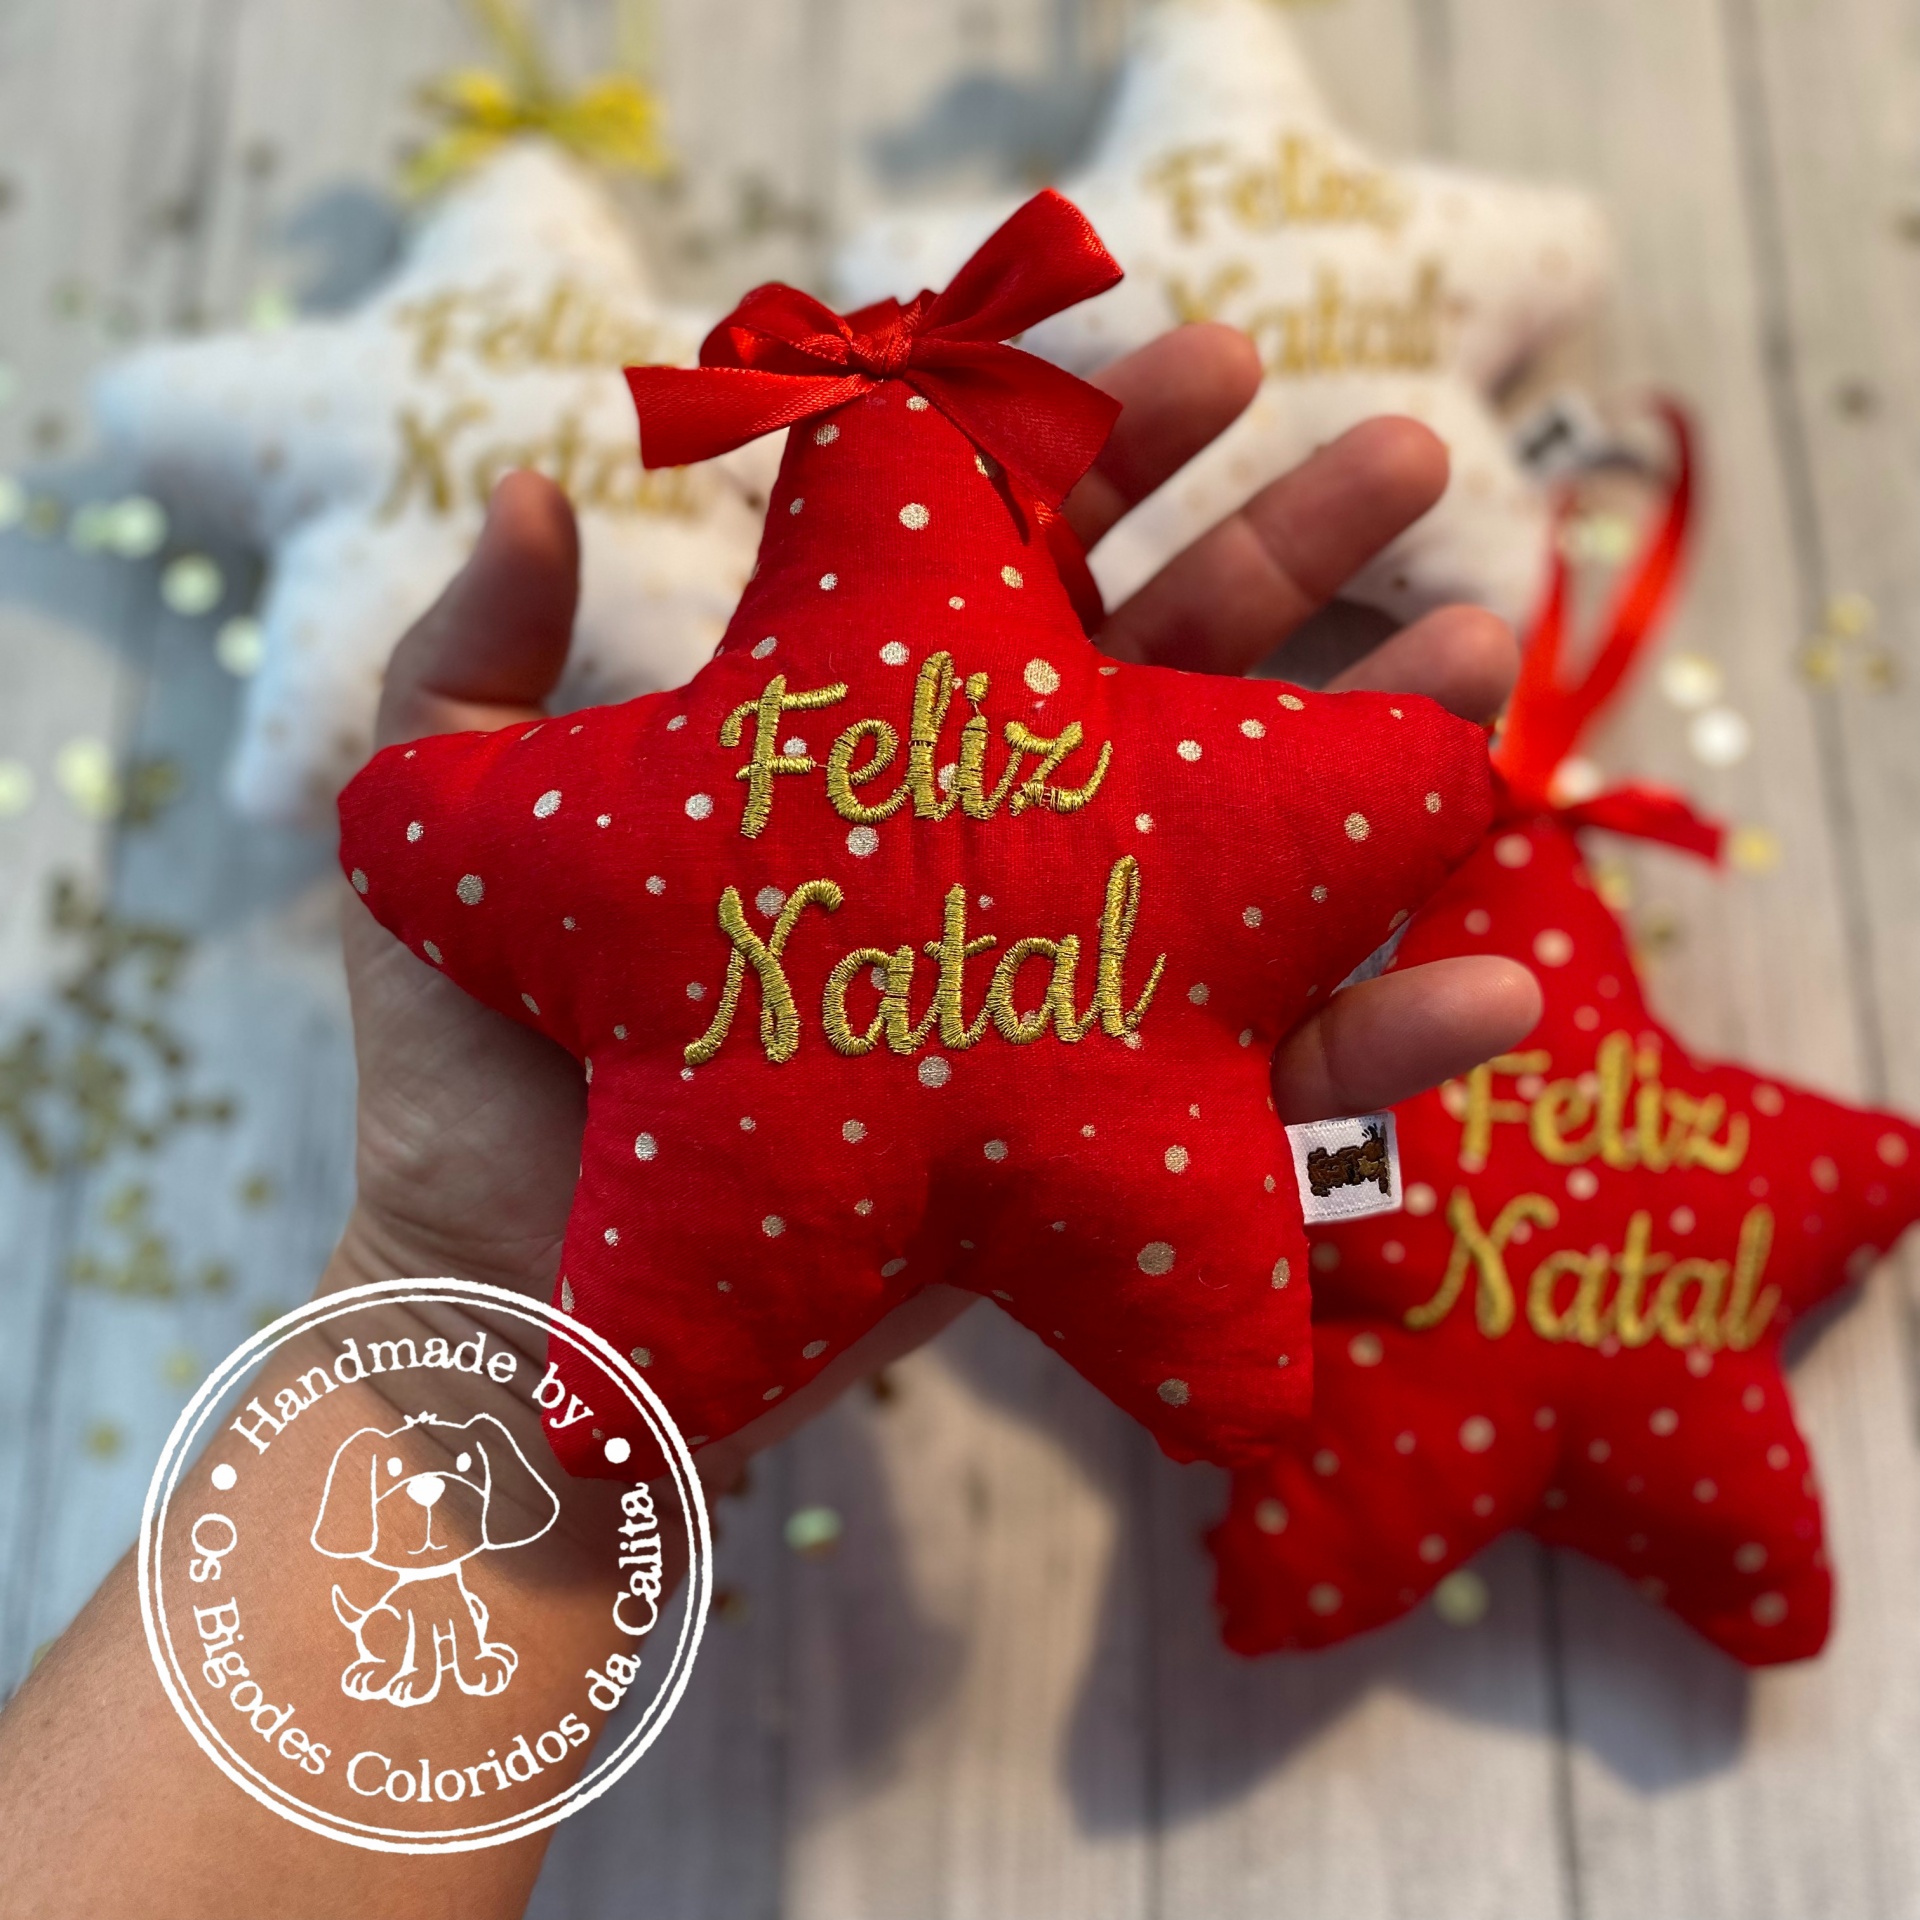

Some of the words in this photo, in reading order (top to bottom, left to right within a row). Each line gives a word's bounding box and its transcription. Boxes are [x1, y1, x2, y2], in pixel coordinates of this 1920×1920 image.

[720, 651, 1113, 838] Feliz
[684, 855, 1166, 1064] Natal
[1440, 1030, 1750, 1174] Feliz
[1404, 1186, 1782, 1352] Natal
